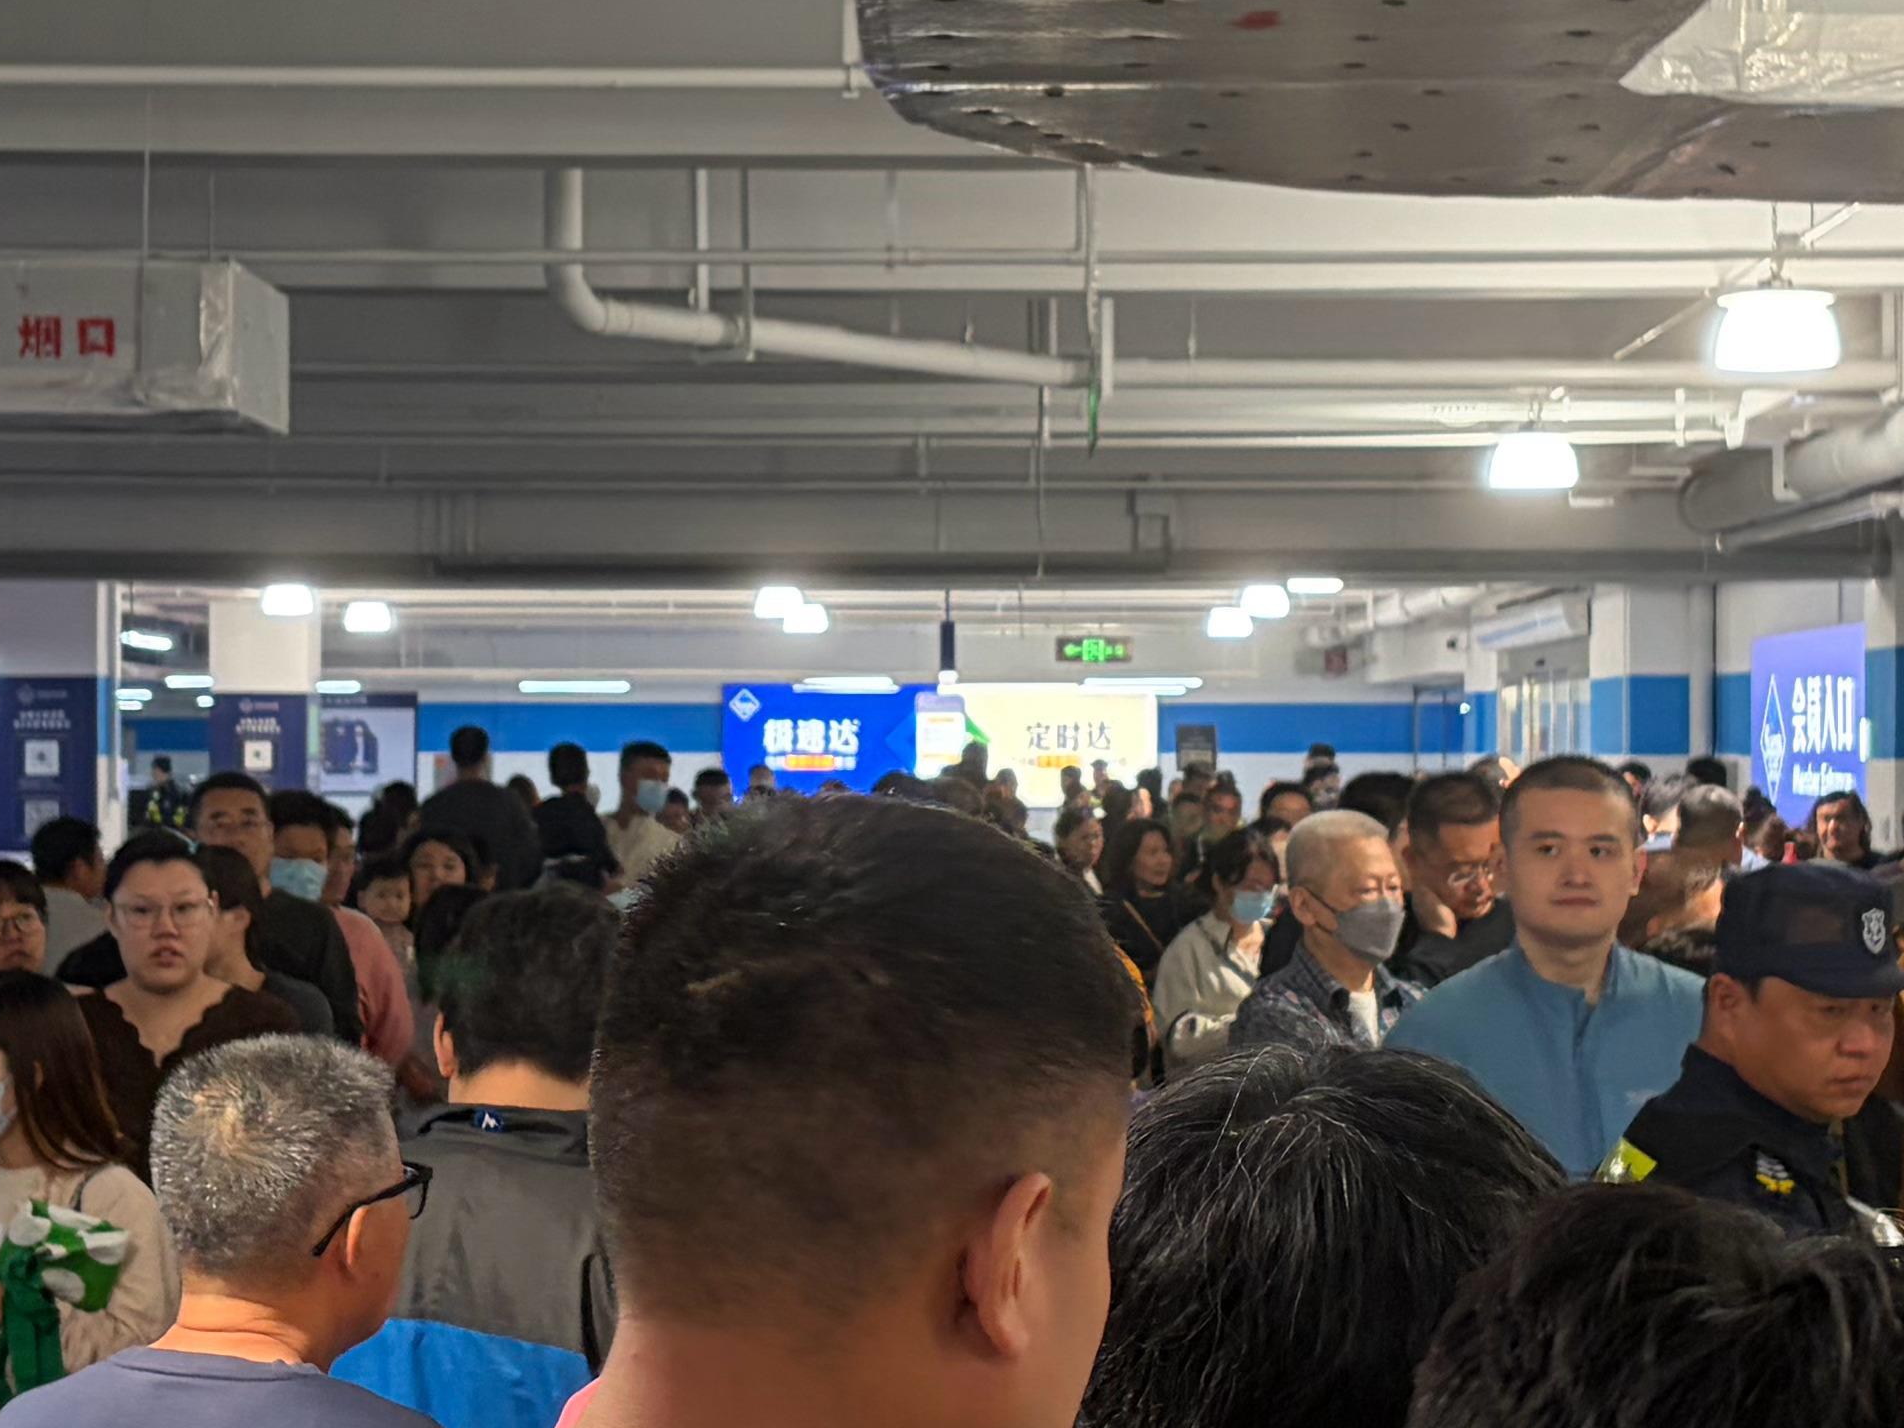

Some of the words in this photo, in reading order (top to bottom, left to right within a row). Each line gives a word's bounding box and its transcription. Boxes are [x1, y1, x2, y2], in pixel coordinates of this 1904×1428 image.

[1026, 721, 1122, 751] 定时达
[1792, 674, 1855, 754] 会员入口
